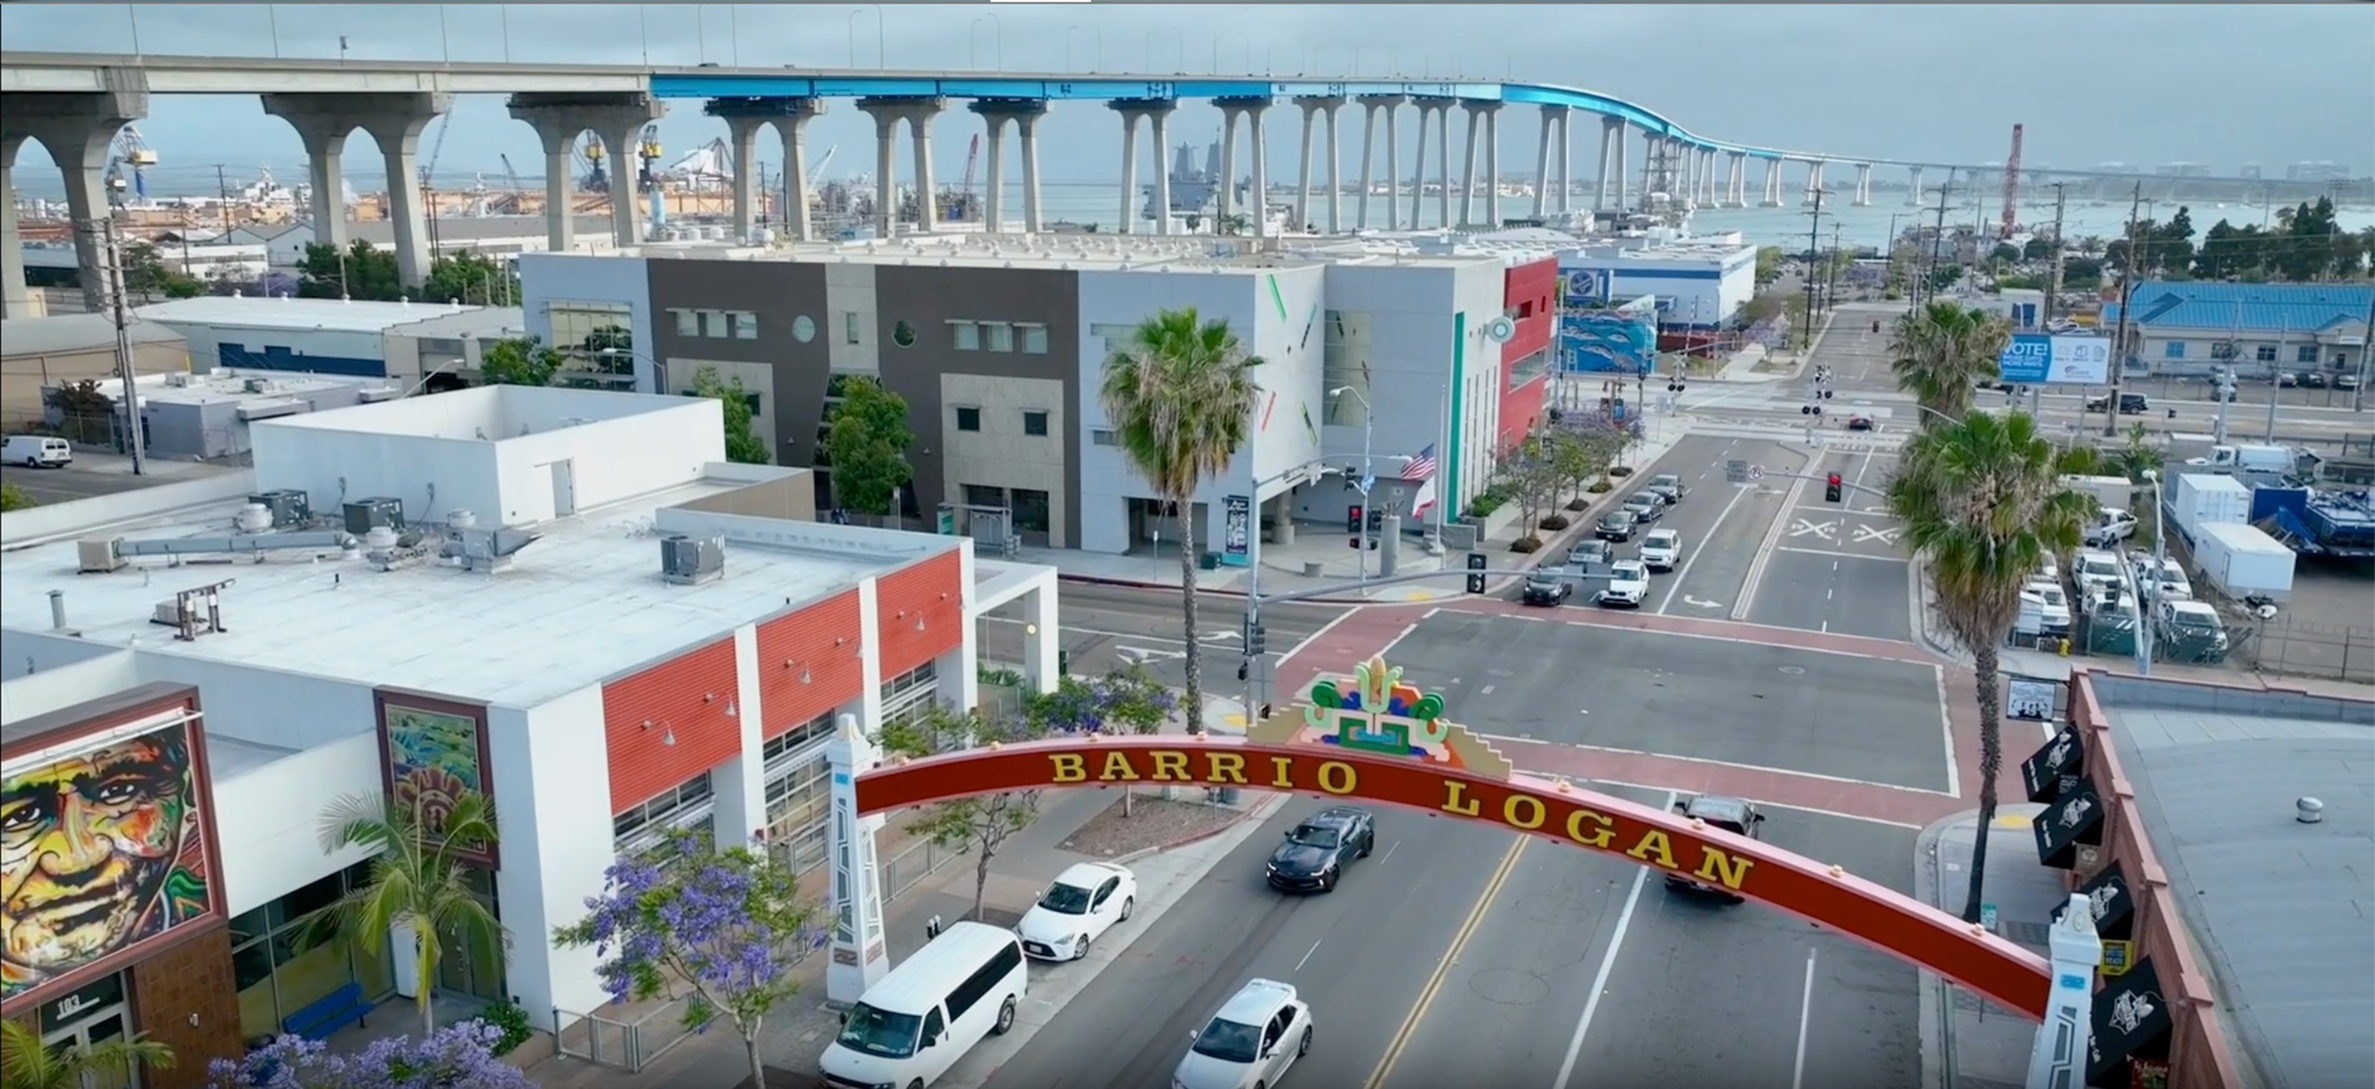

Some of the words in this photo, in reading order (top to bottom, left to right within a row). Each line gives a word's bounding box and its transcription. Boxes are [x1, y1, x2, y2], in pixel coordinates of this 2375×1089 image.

[1050, 751, 1358, 794] BARRIO
[1444, 780, 1753, 890] LOGAN
[57, 994, 80, 1015] 103
